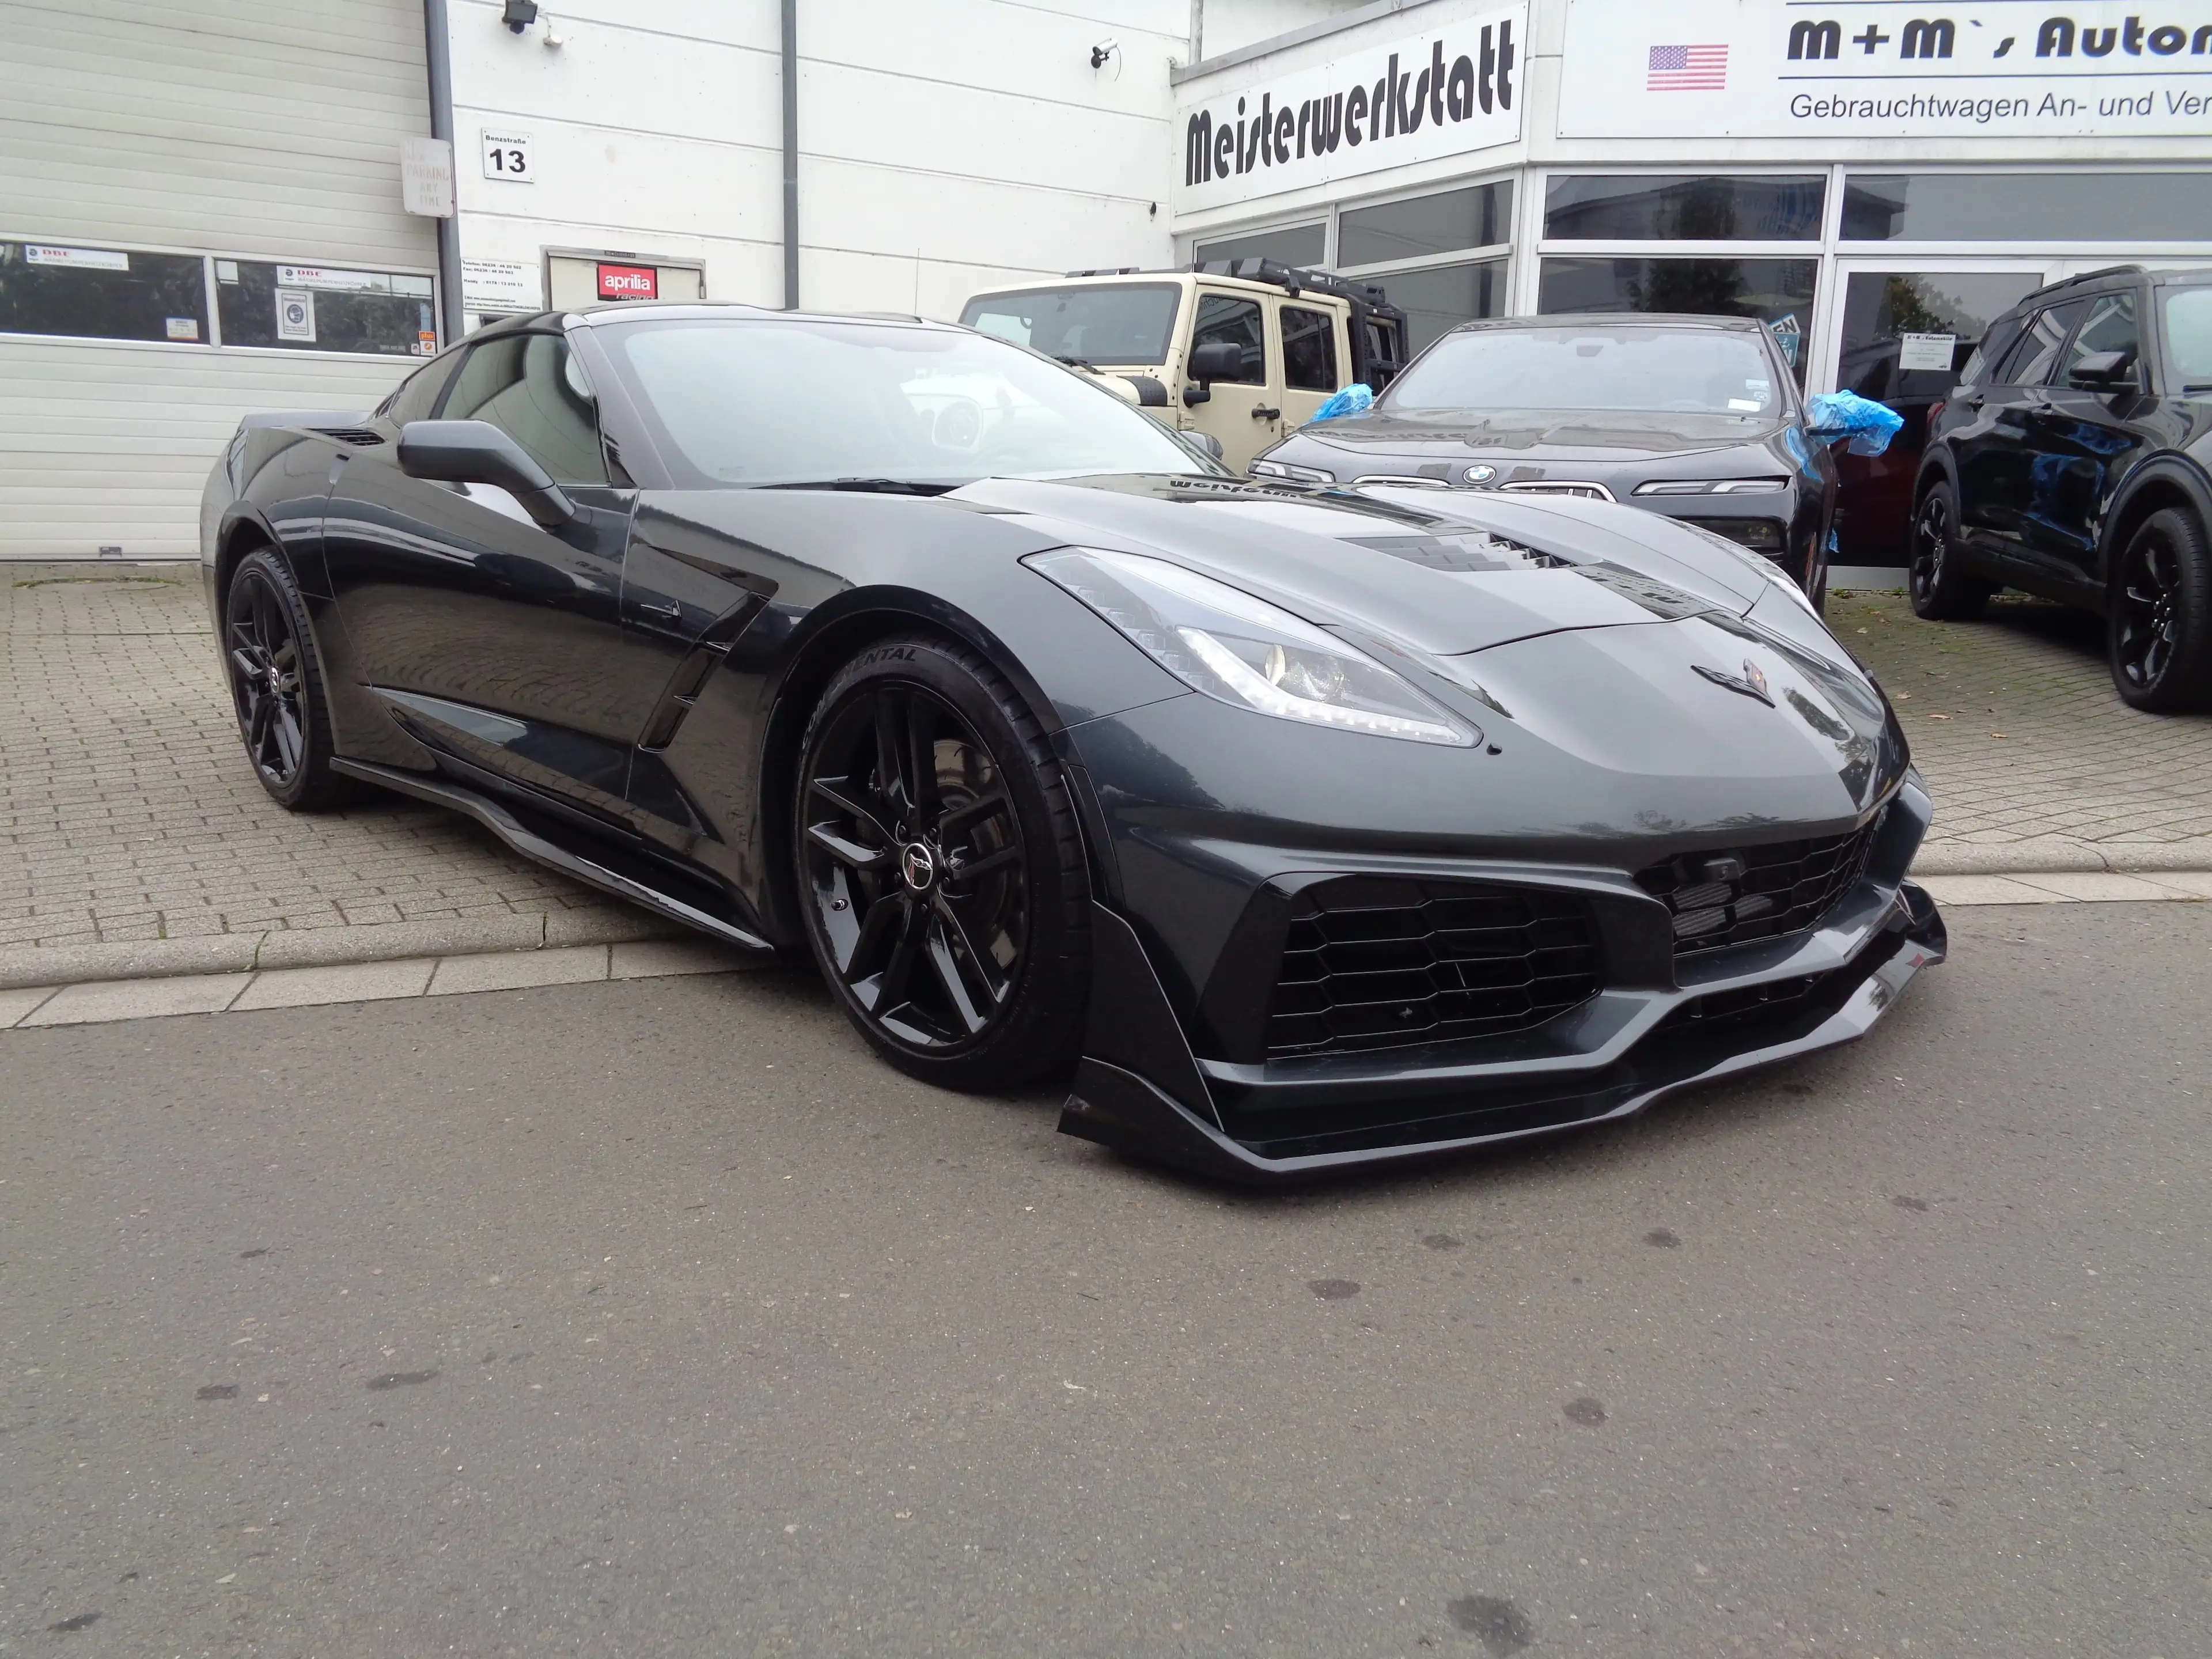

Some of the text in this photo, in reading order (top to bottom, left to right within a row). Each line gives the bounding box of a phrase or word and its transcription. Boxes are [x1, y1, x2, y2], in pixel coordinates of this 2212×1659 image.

[1185, 19, 1514, 187] Meisterwerkstatt
[1790, 93, 2029, 123] Gebrauchtwagen
[2036, 92, 2087, 116] An-
[2099, 90, 2154, 116] und
[486, 135, 527, 145] Benzstraße
[490, 149, 526, 173] 13
[407, 163, 449, 181] PARKING
[605, 274, 650, 291] aprilia
